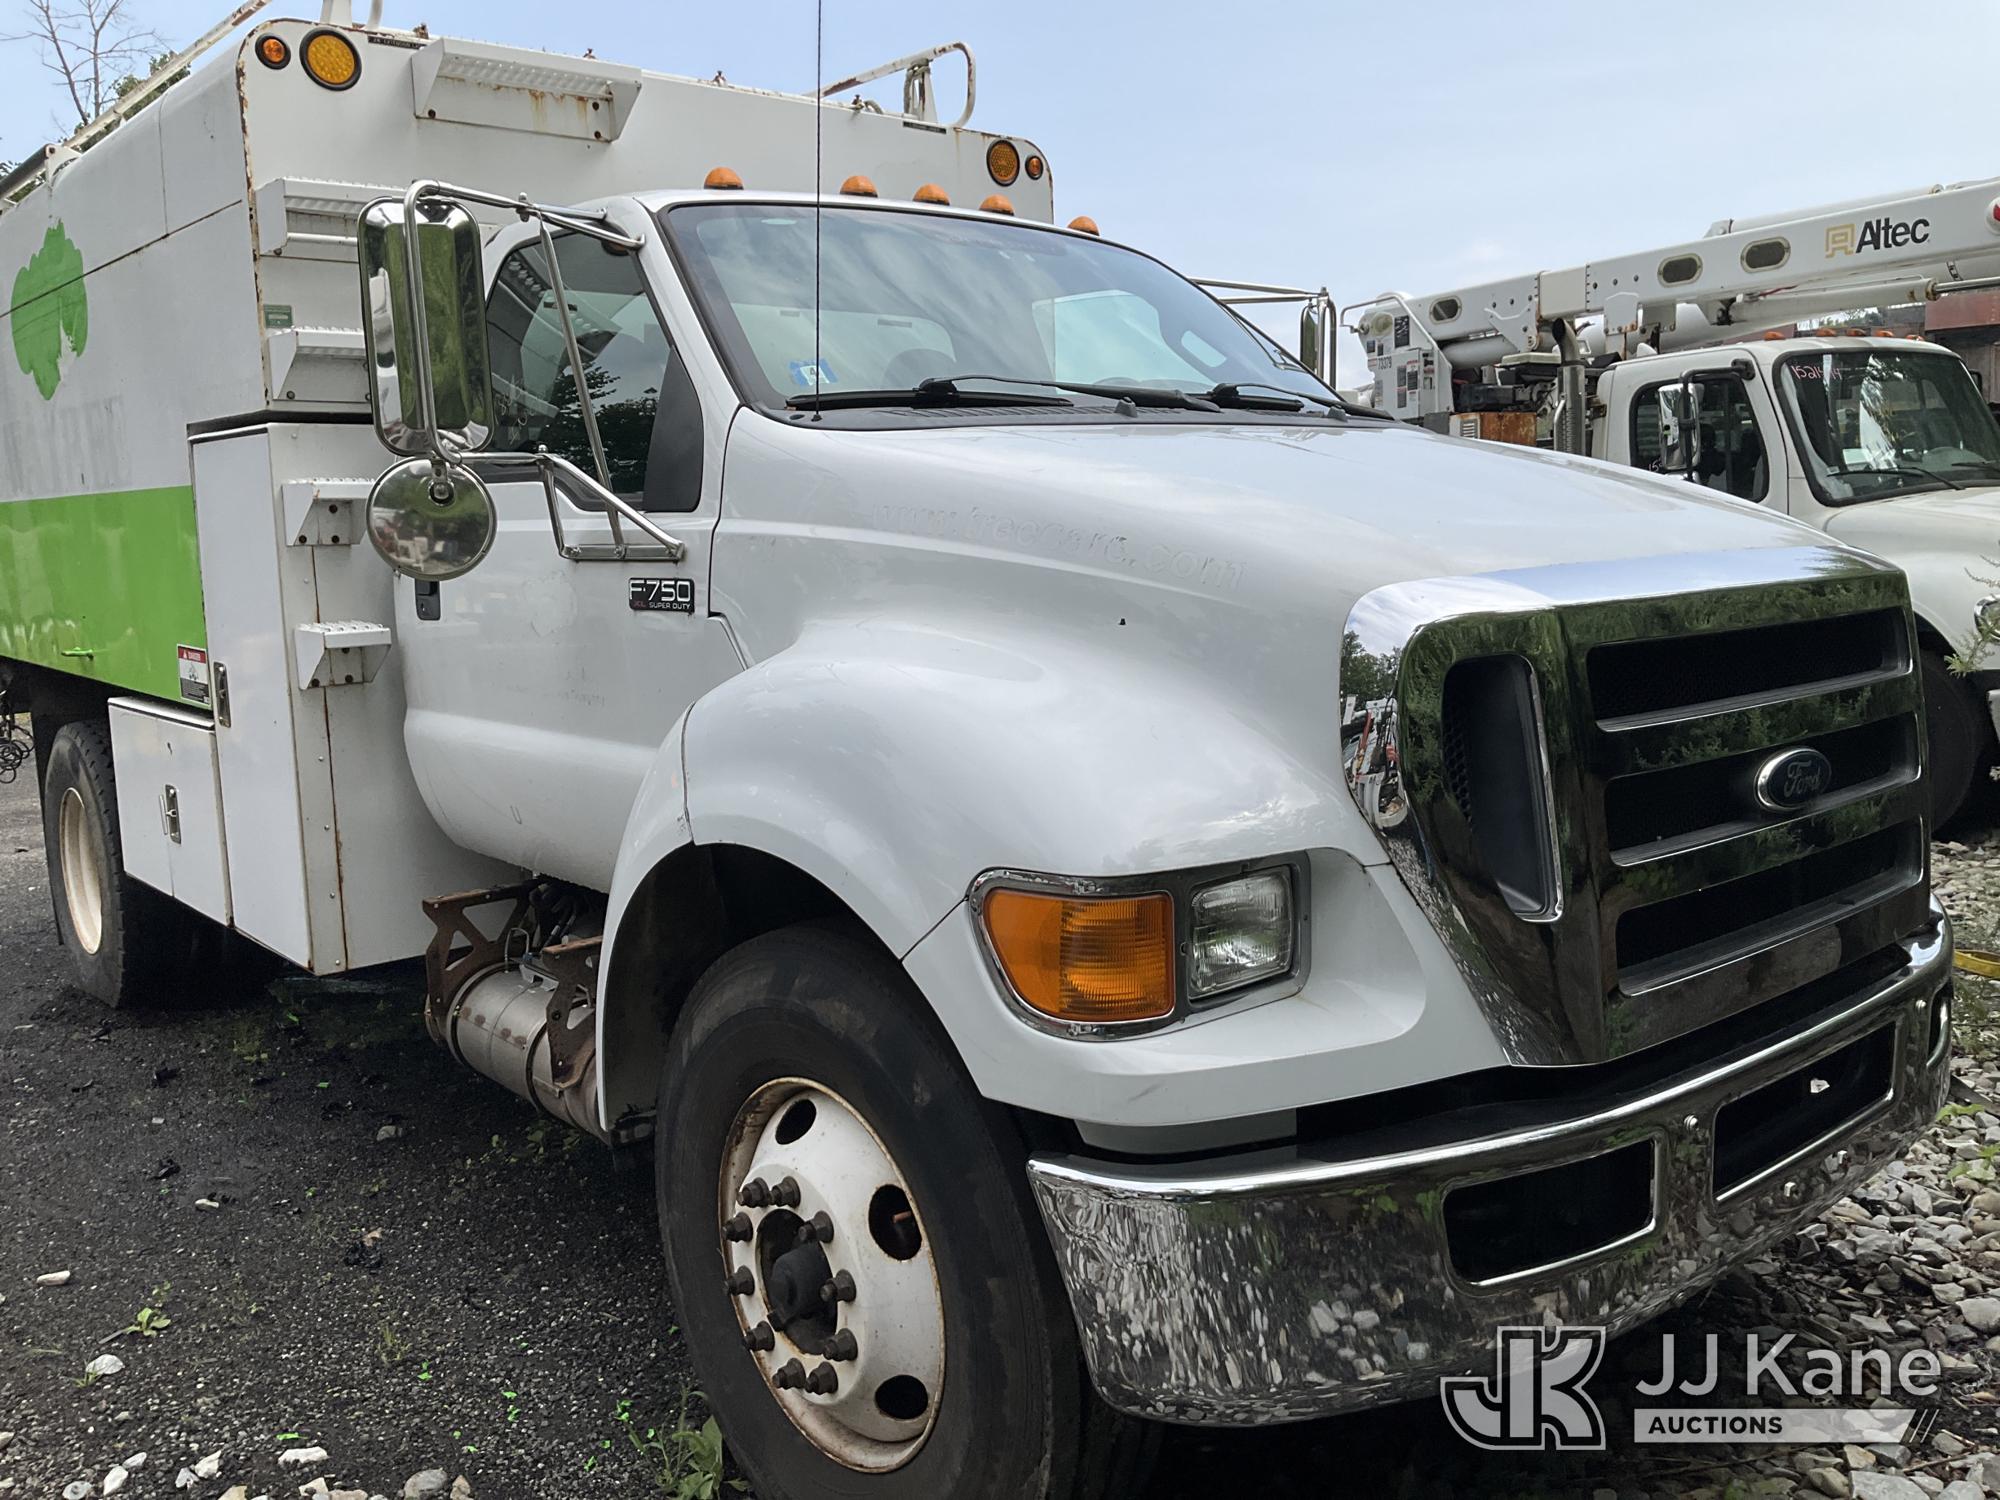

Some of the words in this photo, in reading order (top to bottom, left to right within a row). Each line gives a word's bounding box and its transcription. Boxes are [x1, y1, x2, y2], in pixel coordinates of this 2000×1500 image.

[1855, 217, 1930, 254] Altec
[672, 602, 690, 610] DUTY
[1783, 760, 1821, 798] Ford
